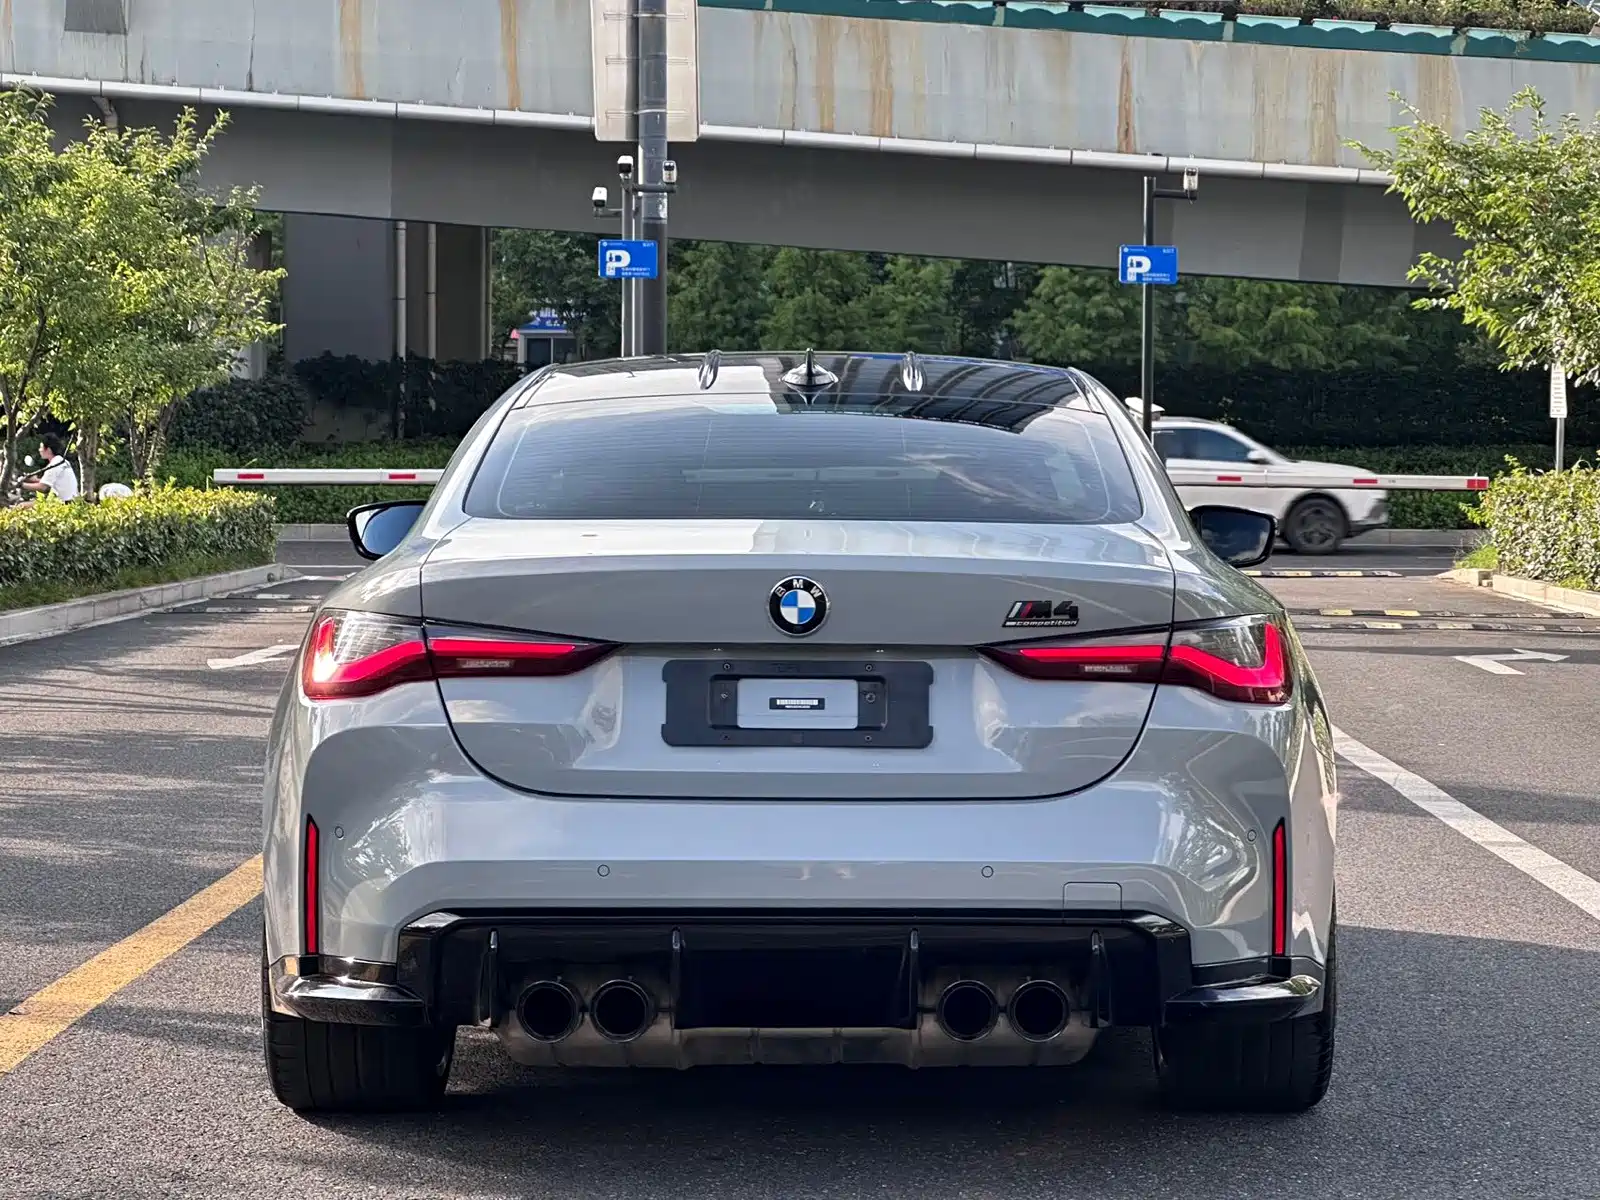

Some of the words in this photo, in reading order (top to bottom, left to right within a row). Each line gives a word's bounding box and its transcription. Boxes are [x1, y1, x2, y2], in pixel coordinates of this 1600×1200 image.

[606, 250, 631, 276] P
[1127, 256, 1151, 281] P
[774, 579, 822, 598] BMW
[1021, 600, 1079, 618] M4
